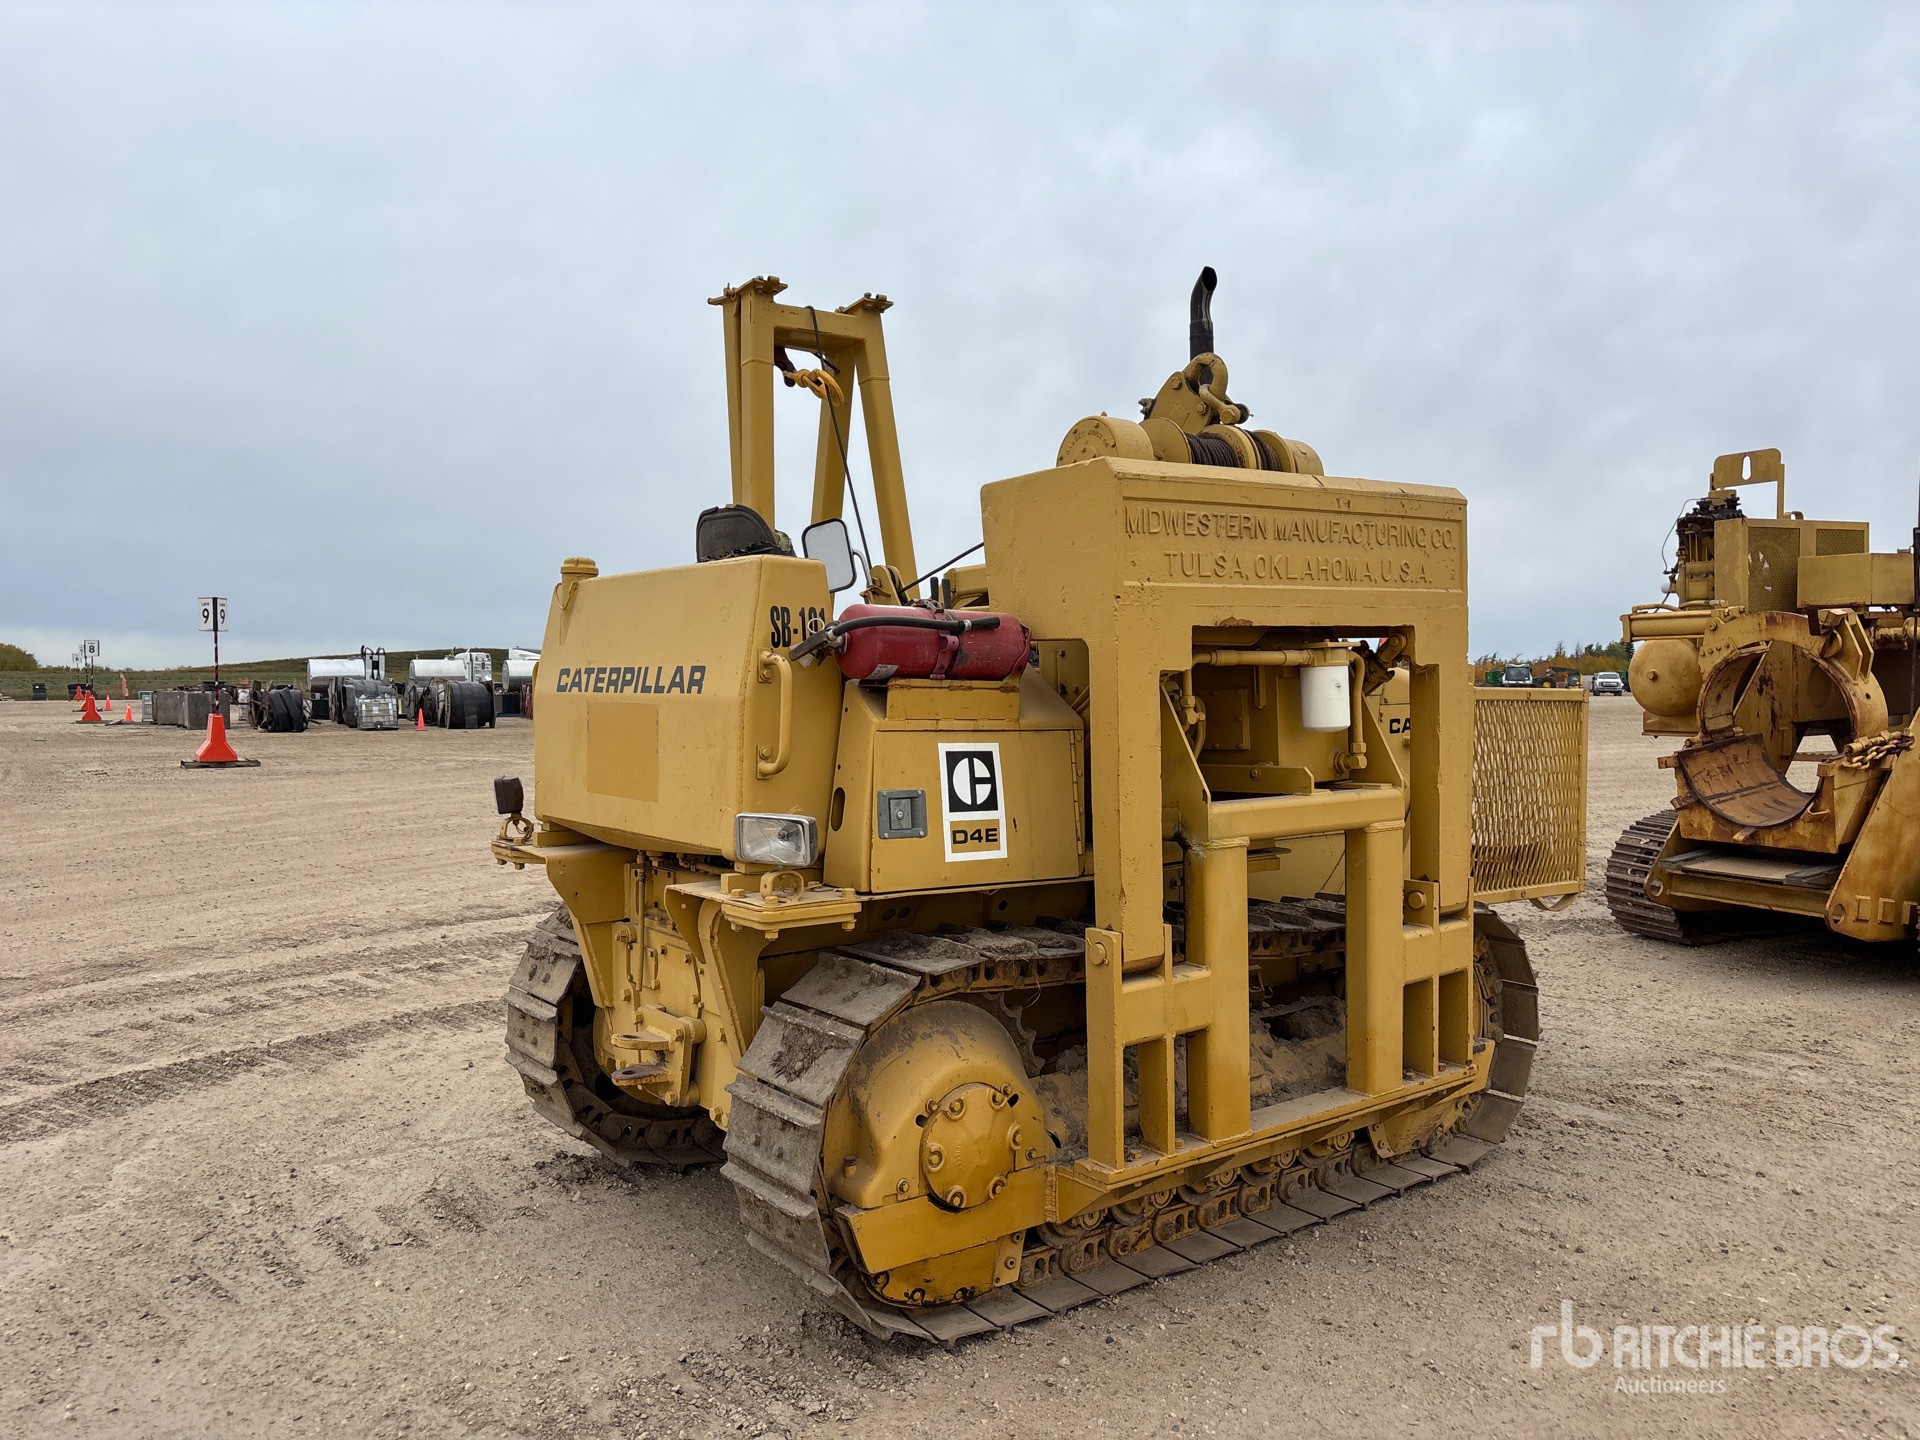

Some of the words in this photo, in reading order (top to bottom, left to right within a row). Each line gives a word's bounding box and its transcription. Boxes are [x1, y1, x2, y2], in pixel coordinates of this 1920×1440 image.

[1125, 507, 1267, 540] MIDWESTERN
[1273, 516, 1426, 549] MANUFACTURING
[1430, 527, 1456, 550] CO.
[1164, 551, 1250, 581] TULSA,
[1254, 553, 1378, 584] OKLAHOMA,
[1380, 559, 1433, 584] U.S.A.
[202, 608, 210, 624] 9
[220, 609, 226, 624] 9
[88, 645, 94, 653] 8
[556, 665, 706, 694] CATERPILLAR
[952, 828, 998, 845] D4E
